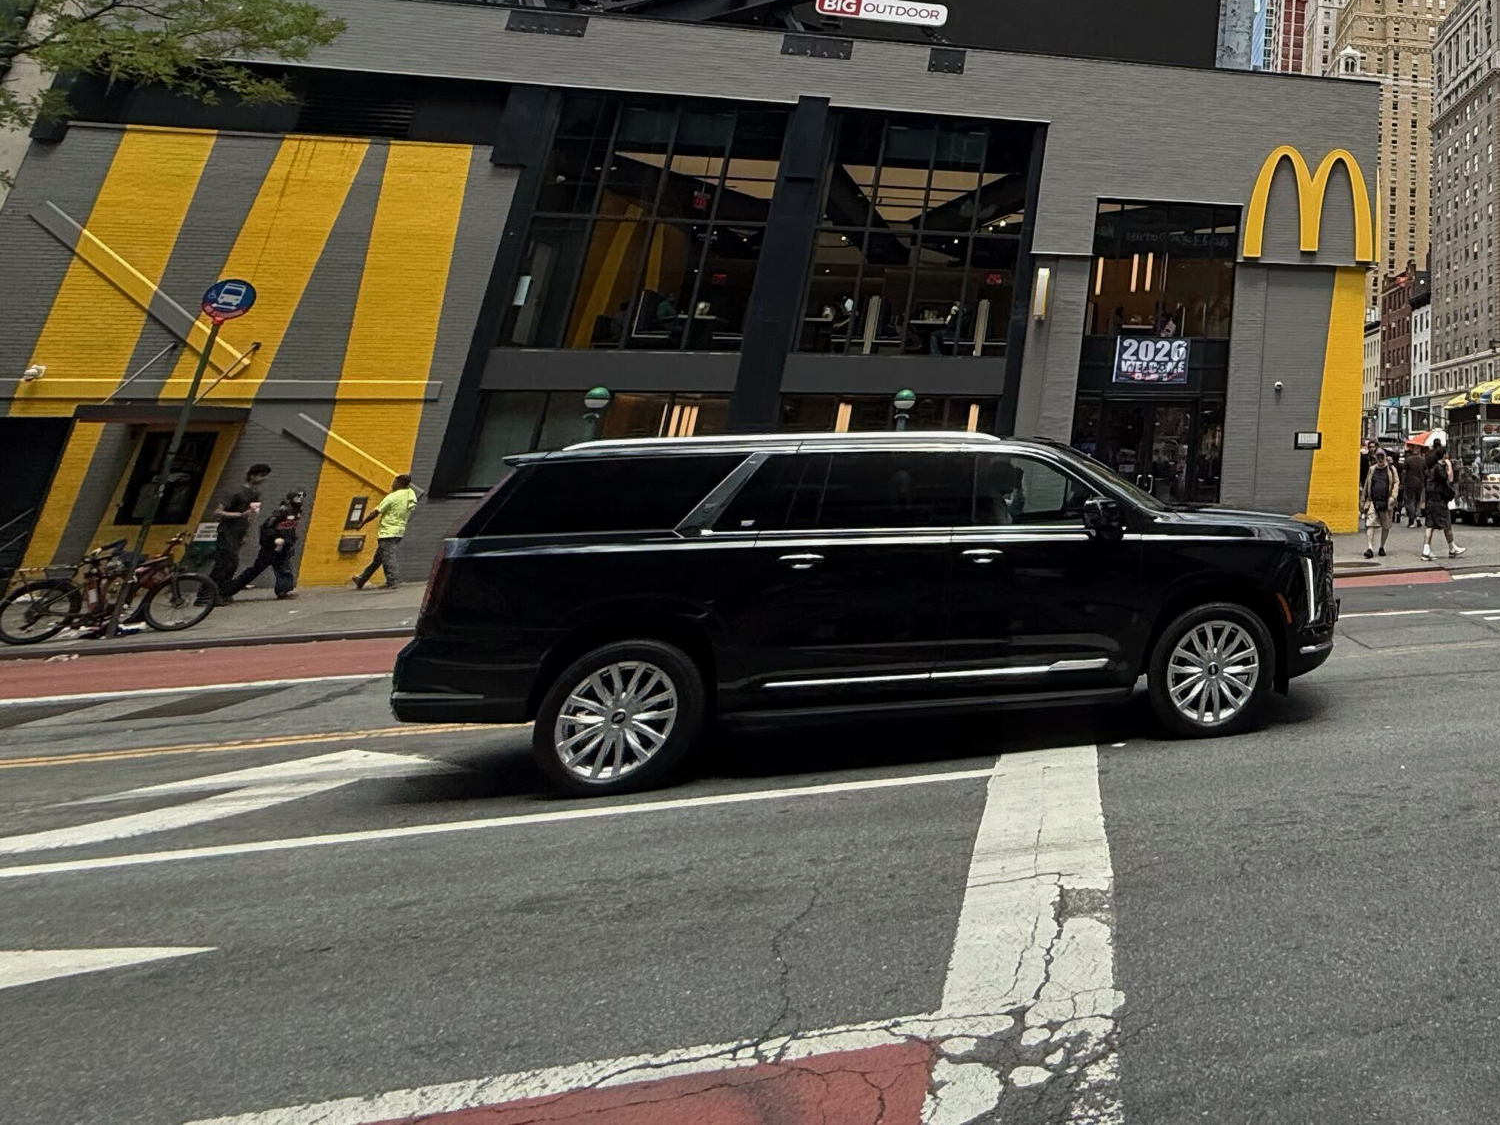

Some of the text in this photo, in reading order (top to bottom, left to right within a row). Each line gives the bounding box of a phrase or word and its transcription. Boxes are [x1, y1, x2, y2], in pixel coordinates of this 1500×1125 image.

[863, 2, 940, 20] OUTDOOR
[1122, 338, 1187, 362] 2026
[1121, 360, 1185, 374] WELCOME
